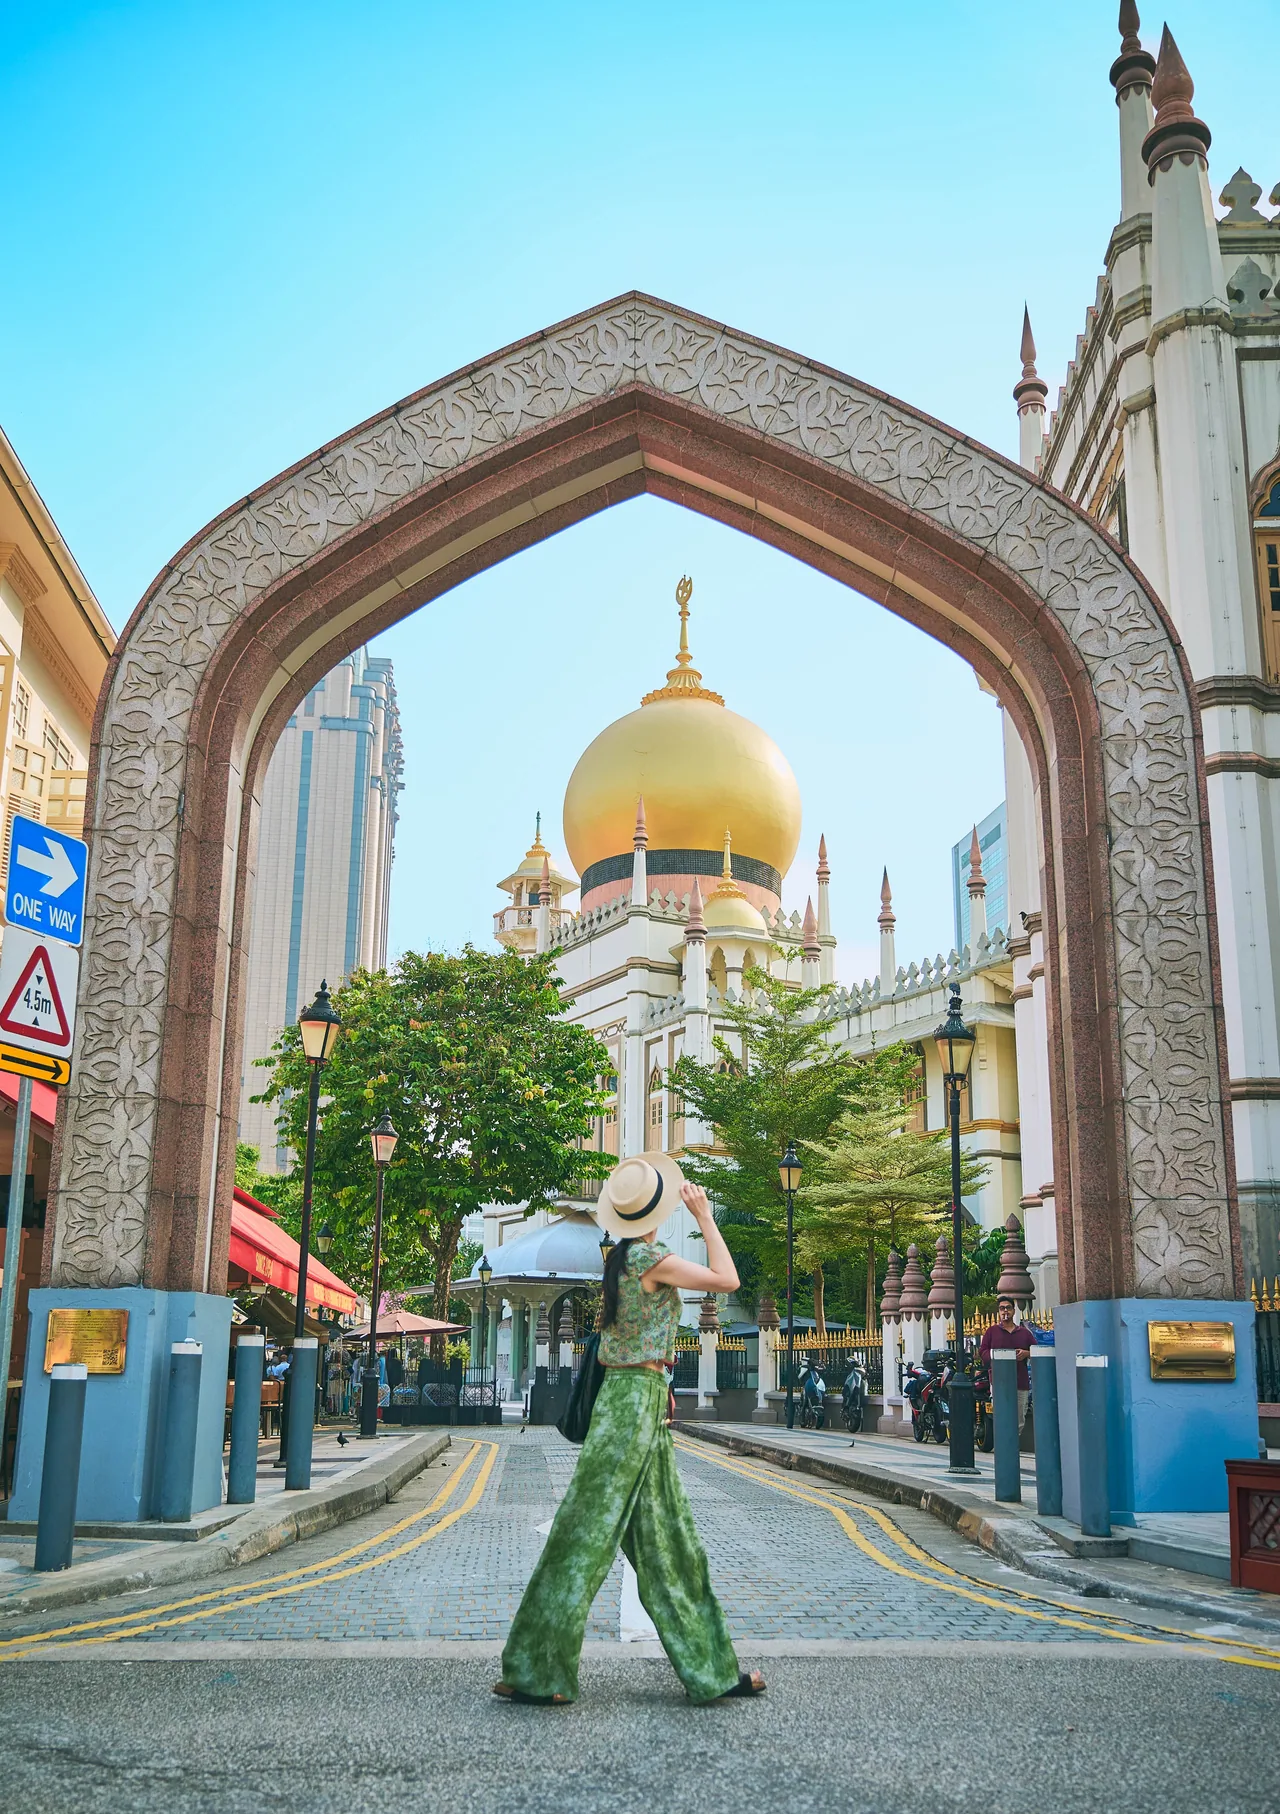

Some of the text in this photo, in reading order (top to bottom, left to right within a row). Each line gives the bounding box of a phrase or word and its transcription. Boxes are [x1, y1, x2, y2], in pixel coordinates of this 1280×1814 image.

[13, 892, 76, 932] ONE WAY
[23, 987, 51, 1014] 4.5m
